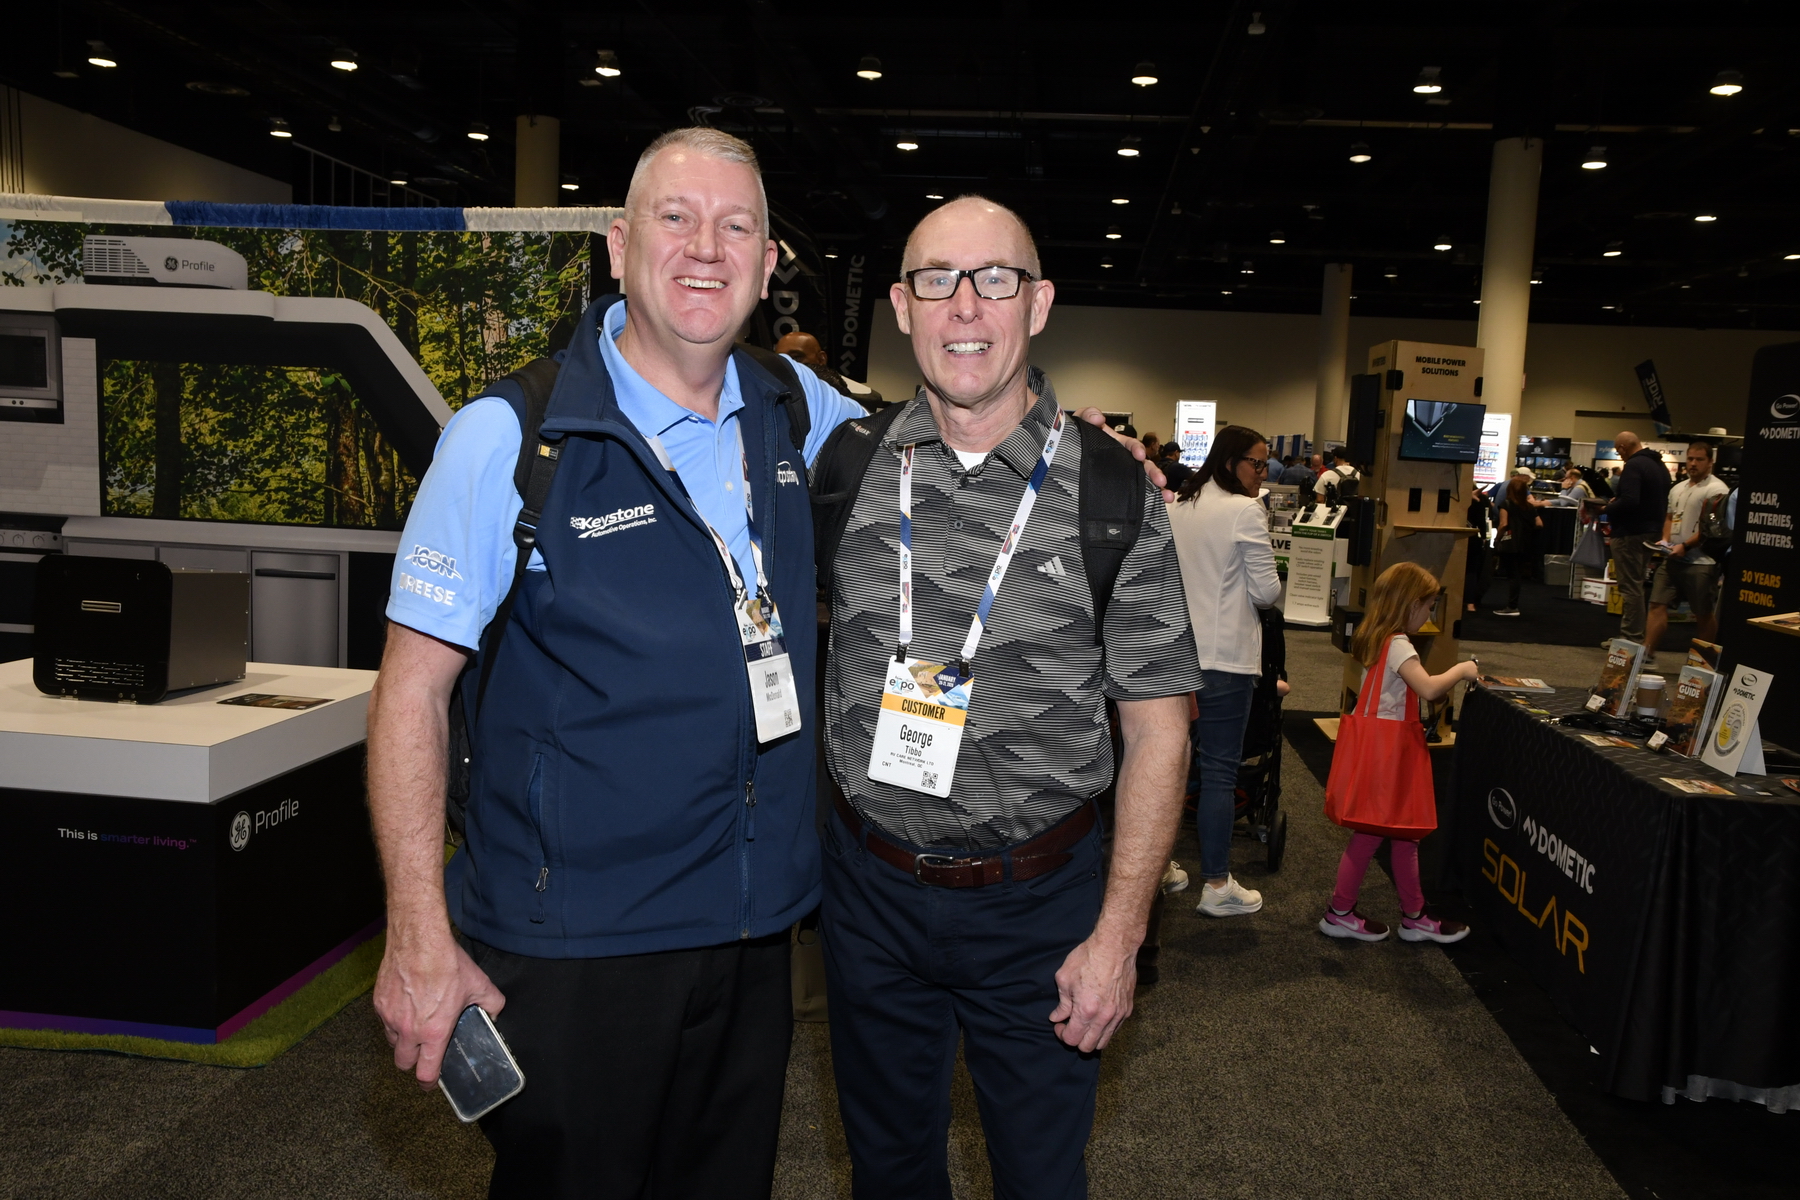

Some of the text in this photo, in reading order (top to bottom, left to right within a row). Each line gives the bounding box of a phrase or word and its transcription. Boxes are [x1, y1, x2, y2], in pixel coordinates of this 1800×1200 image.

[181, 259, 215, 272] Profile
[842, 254, 866, 348] DOMETIC
[1415, 356, 1466, 367] MOBILE POWER
[1421, 366, 1459, 377] SOLUTIONS
[1749, 491, 1780, 509] SOLAR,
[579, 503, 655, 531] Keystone
[1747, 511, 1794, 531] BATTERIES,
[590, 524, 618, 539] Automotive
[1745, 530, 1795, 549] INVERTERS.
[411, 544, 457, 579] ICON
[1741, 569, 1782, 589] 30 YEARS
[406, 575, 457, 607] REESE
[1738, 588, 1776, 608] STRONG.
[1608, 655, 1627, 668] GUIDE
[889, 678, 915, 691] expo
[1678, 684, 1701, 699] GUIDE
[901, 699, 946, 721] CUSTOMER
[899, 724, 933, 749] George
[905, 745, 922, 757] Tibbo
[254, 798, 300, 834] Profile
[57, 827, 85, 840] This
[86, 829, 99, 841] is
[100, 832, 151, 845] smarter
[1537, 825, 1596, 895] DOMETIC
[1481, 837, 1590, 975] SOLAR
